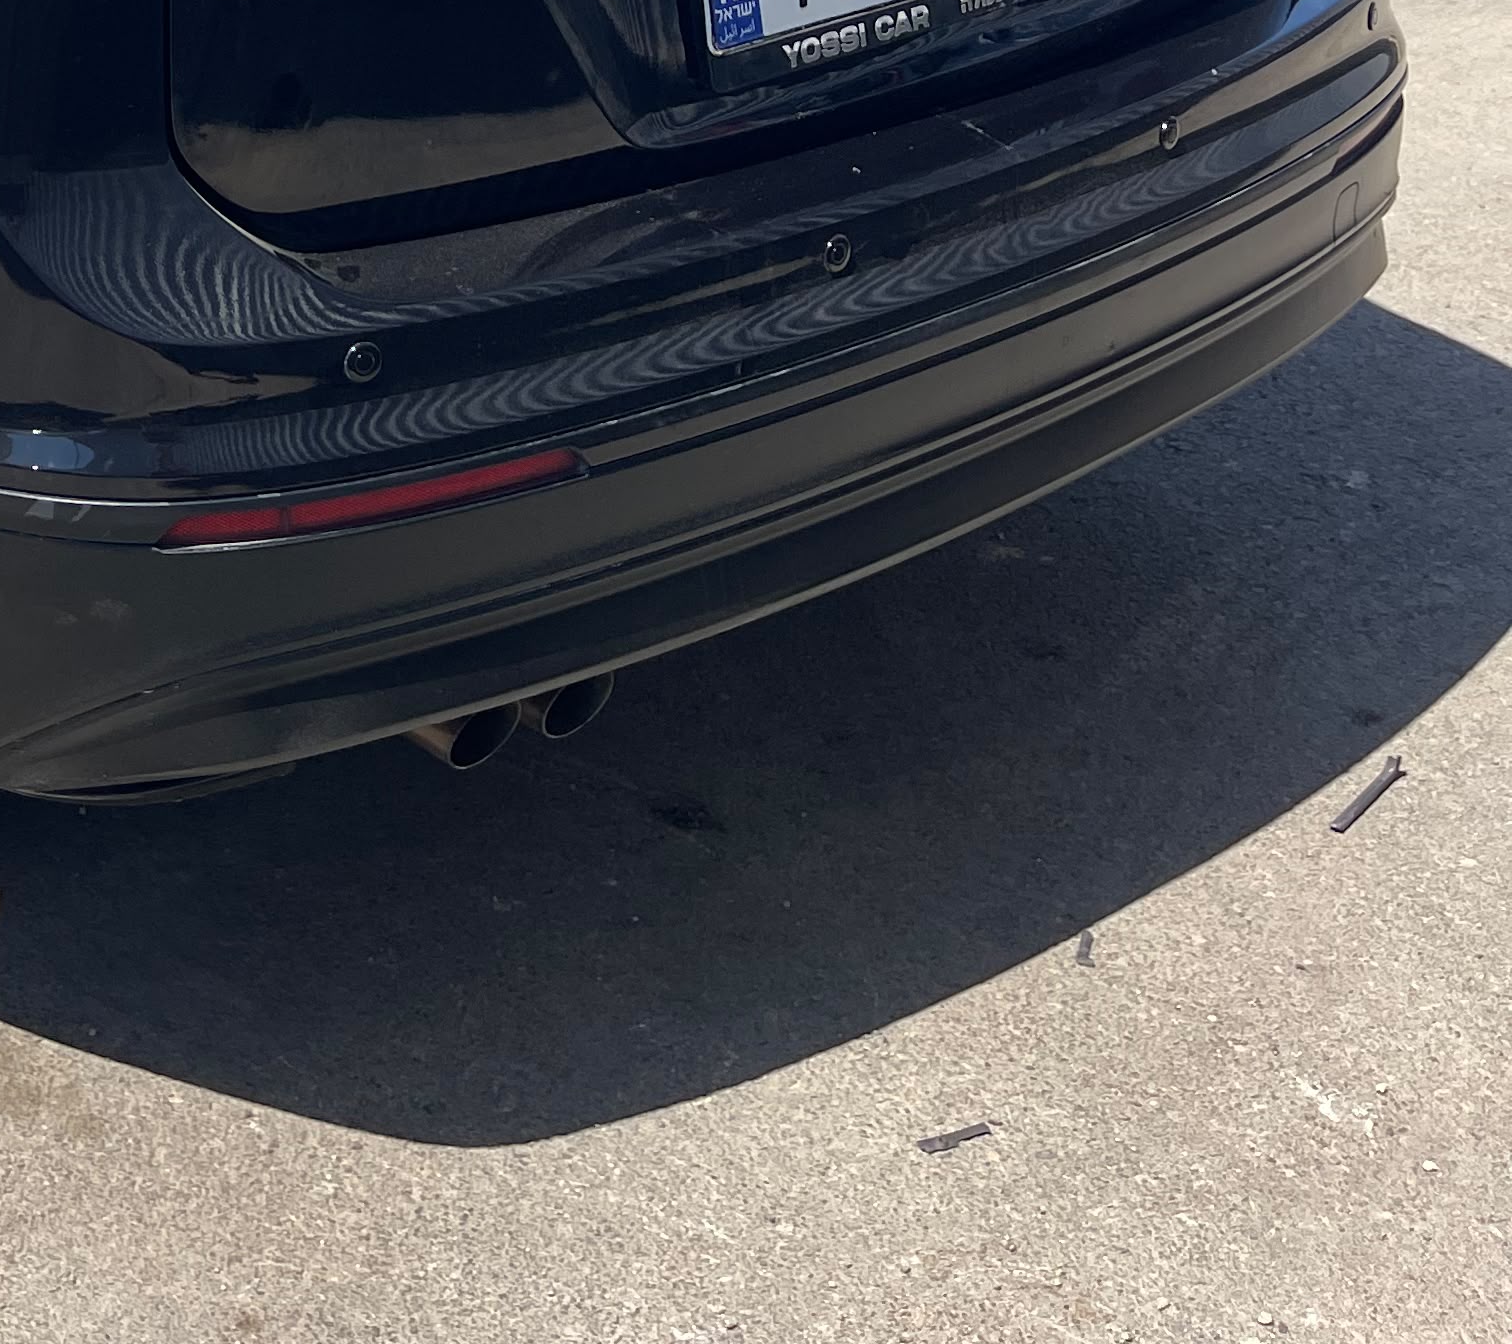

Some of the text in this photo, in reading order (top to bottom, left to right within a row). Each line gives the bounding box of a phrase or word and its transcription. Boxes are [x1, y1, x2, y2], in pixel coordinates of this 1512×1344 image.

[714, 0, 756, 25] ישראל
[781, 22, 868, 68] YOSSI
[874, 4, 930, 41] CAR
